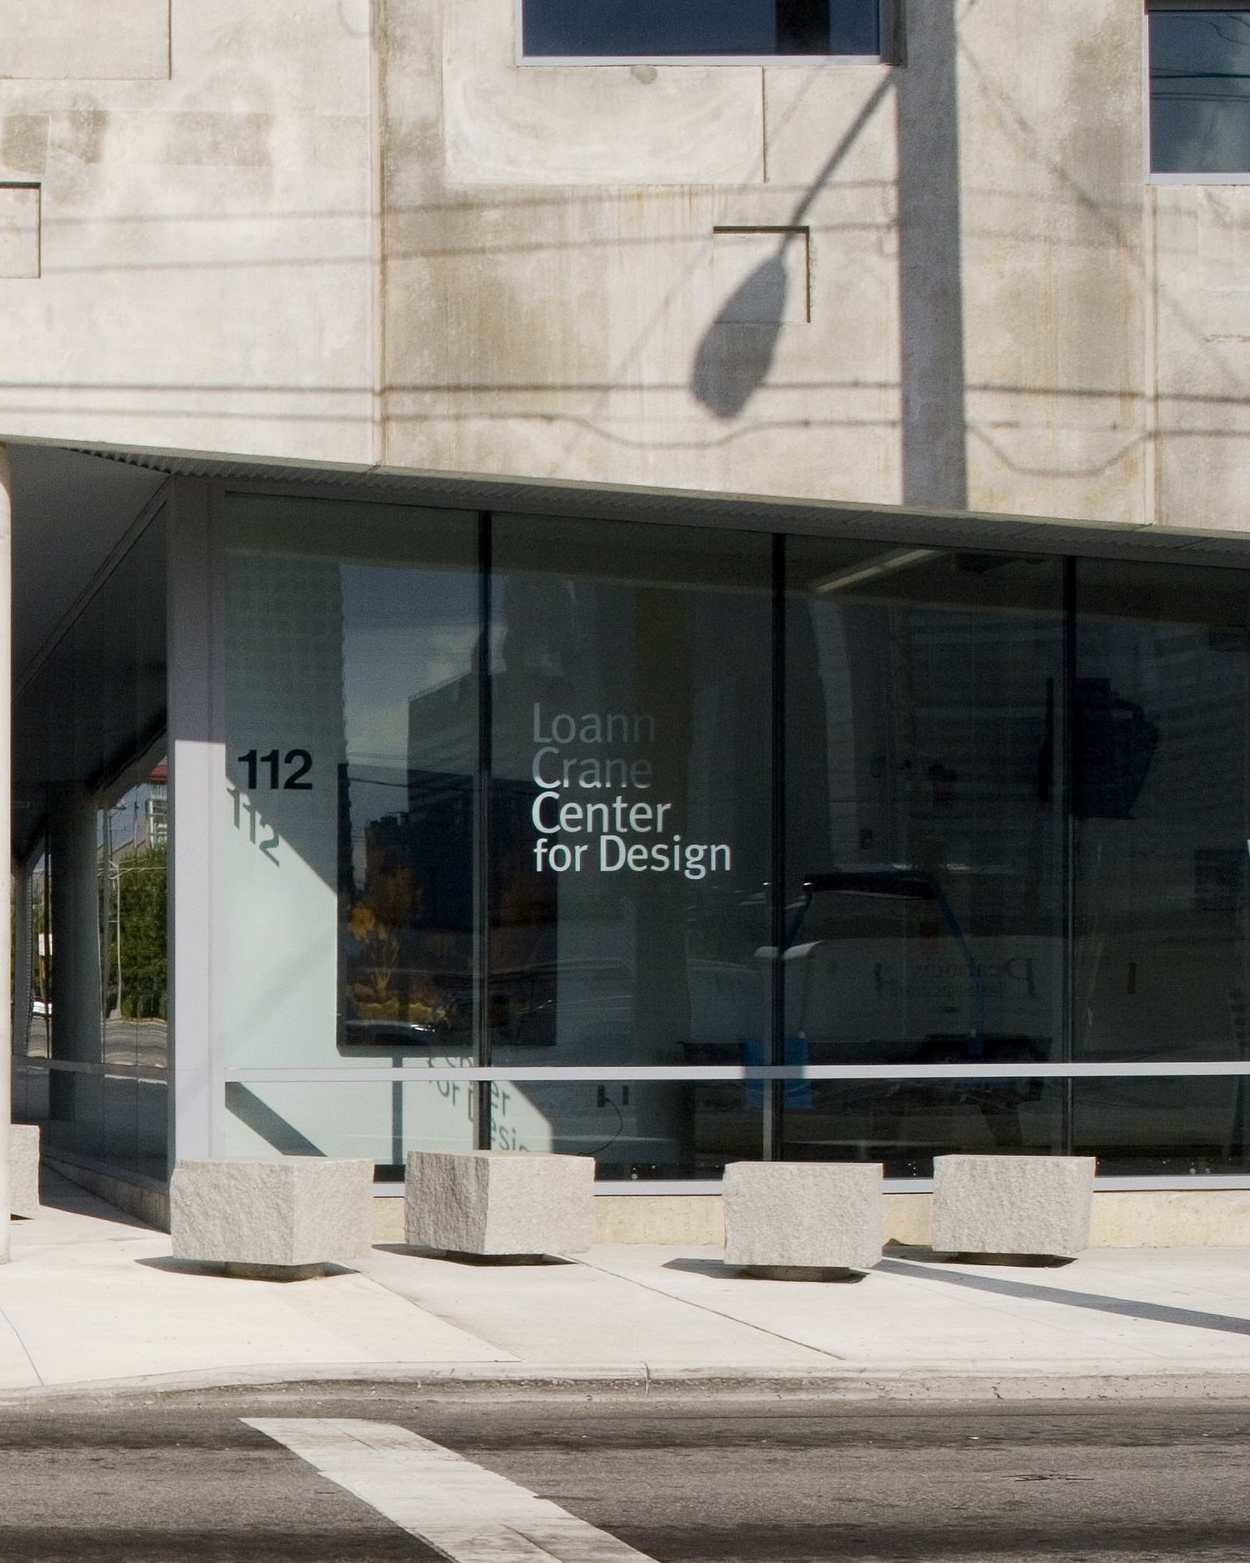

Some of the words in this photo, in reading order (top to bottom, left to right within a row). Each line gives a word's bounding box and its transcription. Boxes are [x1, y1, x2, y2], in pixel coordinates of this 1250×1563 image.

[533, 702, 656, 744] Loann
[238, 748, 313, 790] 112
[532, 746, 653, 789] Crane
[531, 791, 672, 834] Center
[533, 837, 589, 872] for
[599, 834, 731, 880] Design
